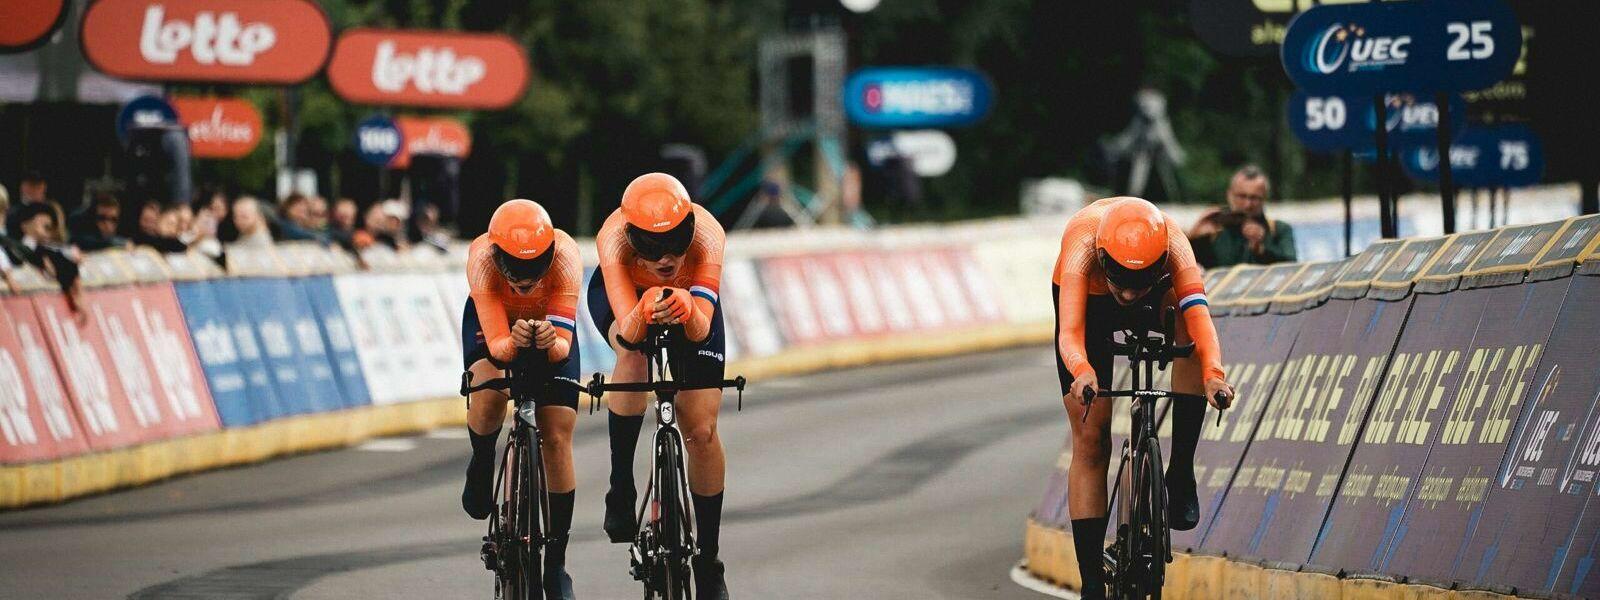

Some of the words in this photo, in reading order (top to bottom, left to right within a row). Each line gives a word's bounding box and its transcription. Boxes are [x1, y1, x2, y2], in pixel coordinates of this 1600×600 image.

[1351, 36, 1411, 61] UEC
[1447, 21, 1495, 60] 25
[1305, 97, 1346, 130] 50
[1499, 141, 1529, 170] 75
